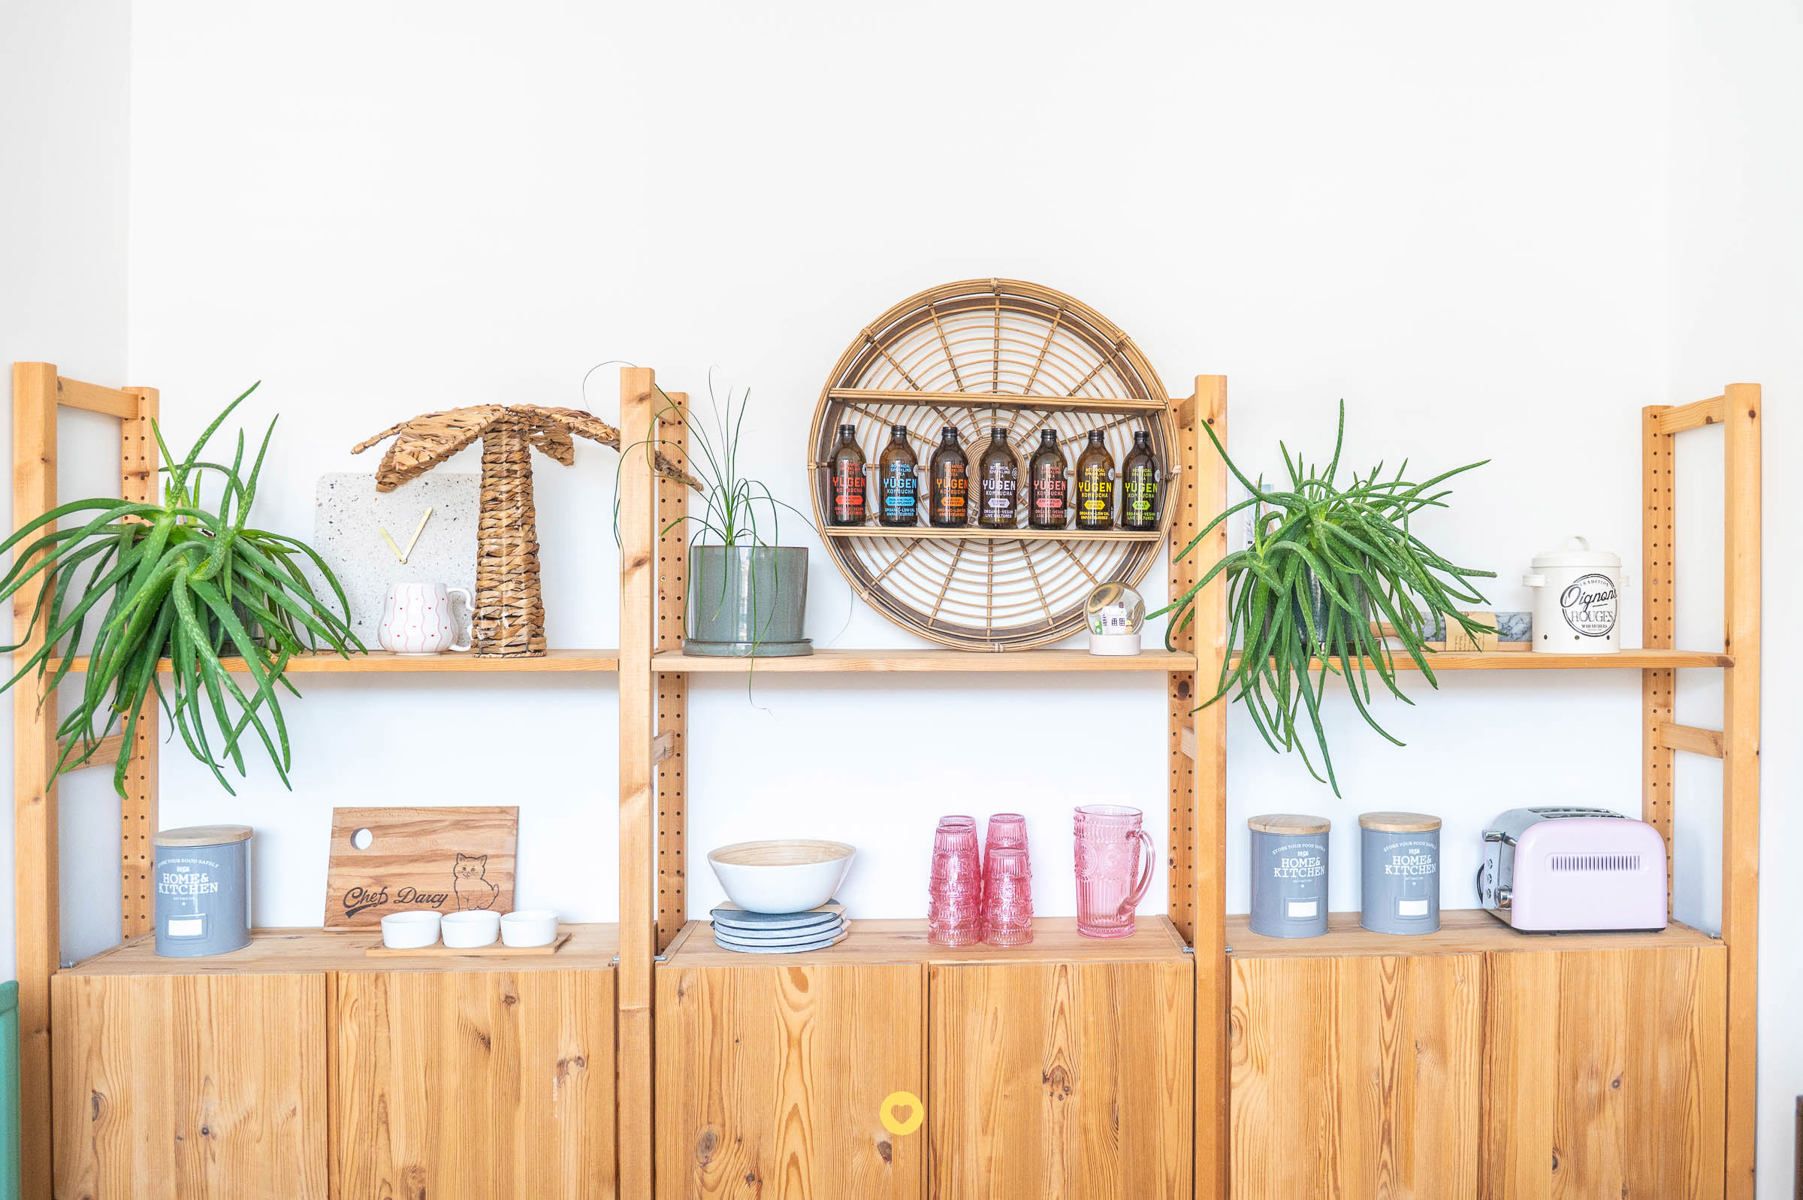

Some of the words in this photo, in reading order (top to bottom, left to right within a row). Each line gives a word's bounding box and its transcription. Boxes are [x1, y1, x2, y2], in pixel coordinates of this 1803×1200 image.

[1560, 584, 1617, 612] Oignons
[1571, 610, 1613, 623] ROUGES
[1273, 865, 1326, 878] KITCHEN
[1385, 863, 1437, 876] KITCHEN
[158, 882, 219, 895] KITCHEN
[343, 886, 389, 918] Chef
[393, 886, 449, 909] Darcy
